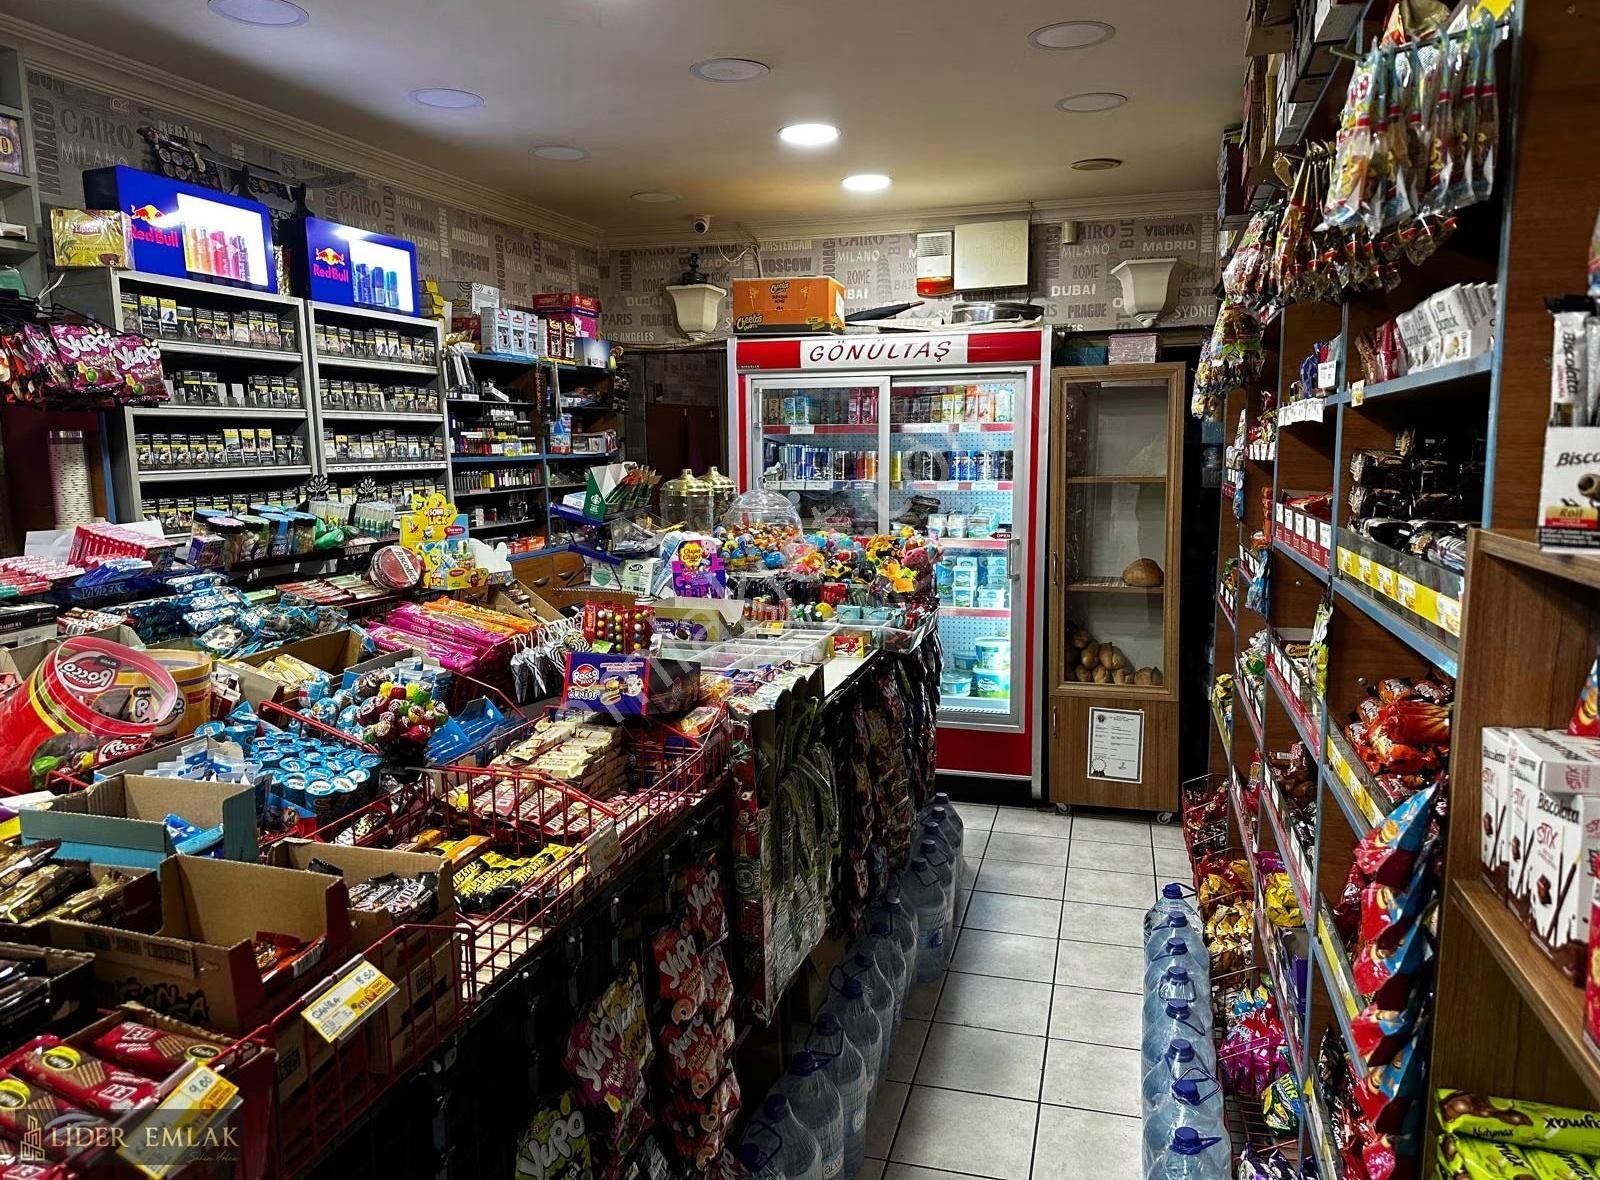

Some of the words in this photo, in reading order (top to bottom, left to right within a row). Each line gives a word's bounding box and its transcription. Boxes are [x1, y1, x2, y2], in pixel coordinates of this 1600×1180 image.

[60, 109, 134, 150] CAIRO
[340, 190, 380, 218] CAIRO
[1142, 223, 1195, 237] VIENNA
[505, 239, 532, 260] CAIRO
[1062, 243, 1110, 259] MILANO
[1142, 240, 1197, 252] MADRID
[836, 249, 881, 263] MILANO
[847, 269, 871, 284] ROME
[1072, 264, 1100, 280] ROME
[1051, 284, 1096, 298] DUBAI
[1067, 303, 1107, 319] PRAGUE
[1173, 305, 1220, 319] SYDNE
[602, 313, 632, 326] PARIS
[736, 312, 763, 330] Cheetos
[620, 331, 655, 341] ANGELES
[809, 337, 953, 363] GÖNÜLTAŞ
[1562, 331, 1581, 394] Biscolata
[428, 515, 448, 526] LICK
[1537, 792, 1580, 825] Biscolata
[1471, 1126, 1514, 1138] Nutymax
